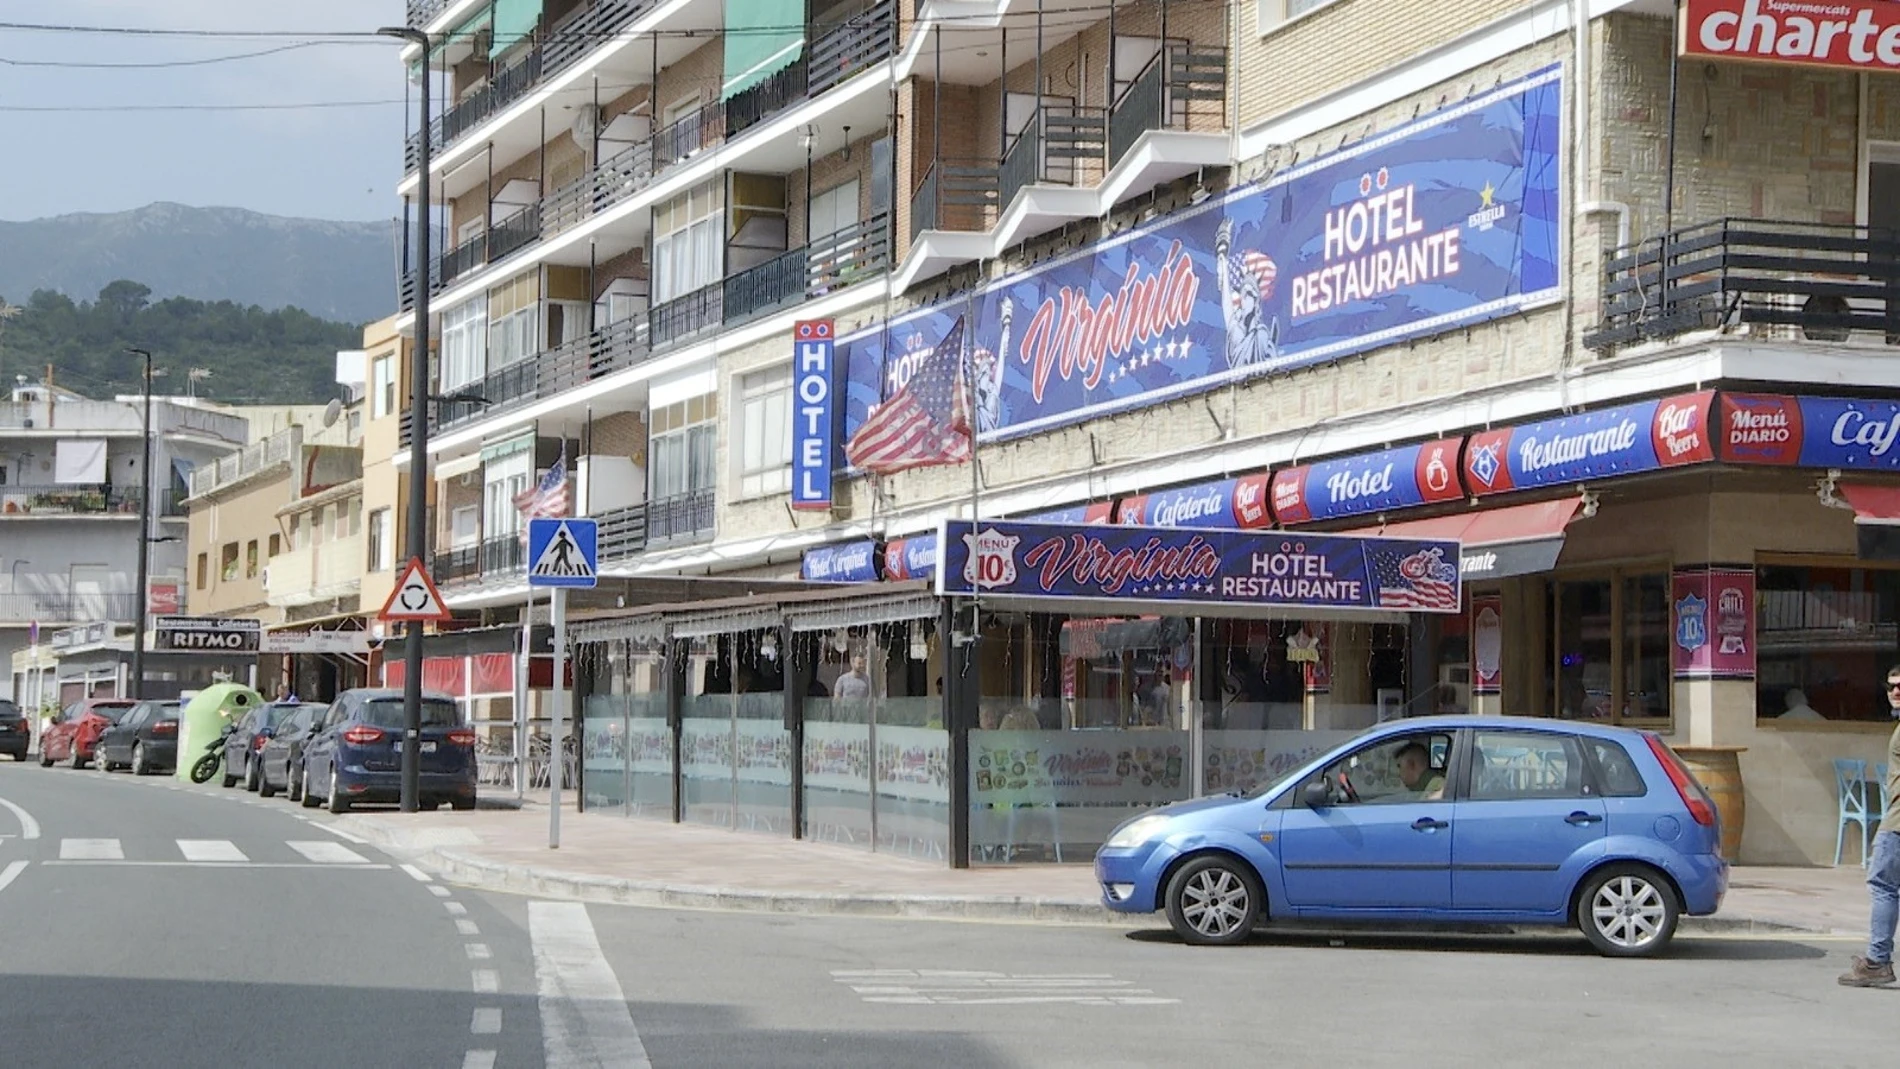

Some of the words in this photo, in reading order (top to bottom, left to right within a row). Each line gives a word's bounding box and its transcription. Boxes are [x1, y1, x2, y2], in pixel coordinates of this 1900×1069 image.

[1766, 0, 1851, 16] Supermercats
[1699, 0, 1900, 66] charte
[1324, 184, 1423, 261] HOTEL
[1291, 228, 1460, 317] RESTAURANTE
[800, 343, 827, 499] HOTEL
[1659, 404, 1698, 439] Bar
[1731, 409, 1789, 429] Menú
[1520, 418, 1637, 473] Restaurante
[1666, 432, 1700, 457] Beers
[1730, 428, 1789, 444] DIARIO
[1237, 482, 1260, 509] Bar
[1326, 463, 1394, 503] Hotel
[1153, 487, 1223, 527] Cafetería
[1251, 553, 1333, 577] HOTEL
[1222, 577, 1361, 600] RESTAURANTE
[173, 631, 243, 648] RITMO
